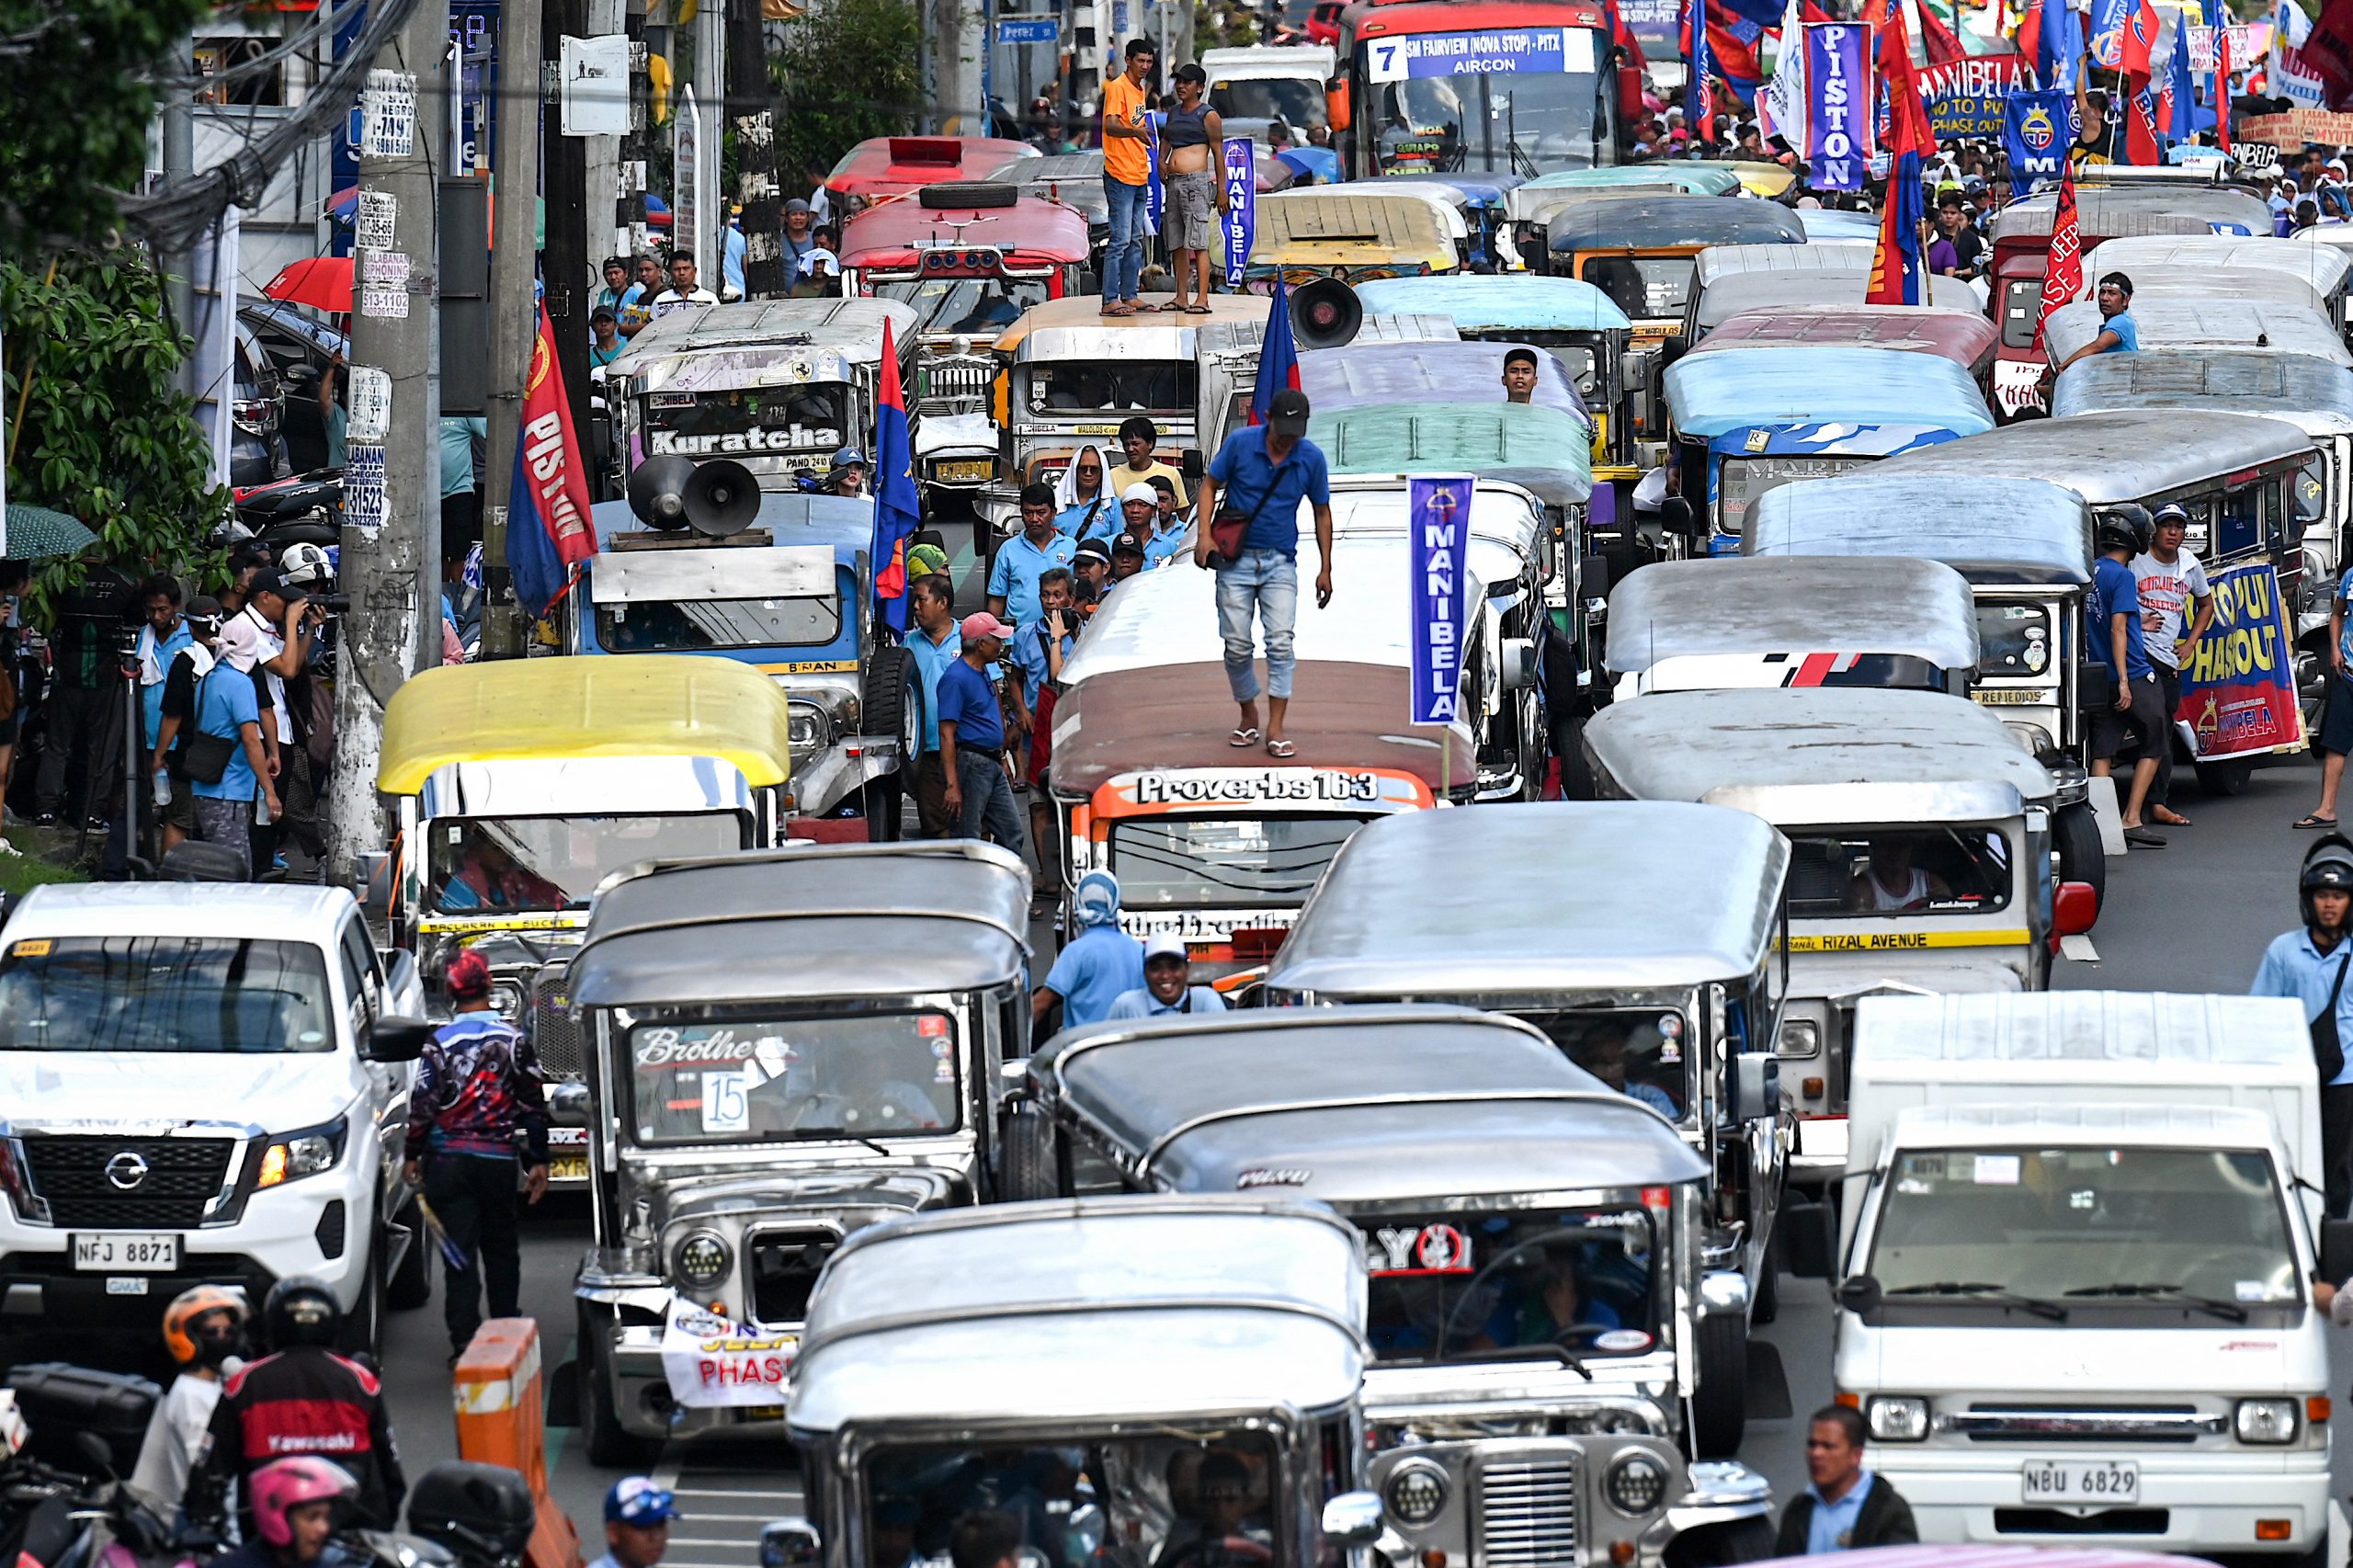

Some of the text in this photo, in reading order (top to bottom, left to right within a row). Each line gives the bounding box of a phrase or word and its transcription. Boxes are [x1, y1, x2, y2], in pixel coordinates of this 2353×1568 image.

[1377, 46, 1396, 71] 7
[1406, 41, 1422, 58] SM
[1423, 38, 1468, 56] FAIRVIEW
[1471, 35, 1501, 58] (NOVA
[1502, 34, 1530, 55] STOP)
[1537, 34, 1561, 51] PITX
[1453, 58, 1516, 74] AIRCON
[1917, 60, 2025, 105] MANIBELA
[1824, 26, 1850, 185] PISTON
[1951, 98, 1975, 114] TO
[1932, 119, 1974, 134] PHASE
[1227, 166, 1245, 282] MANIBELA
[363, 264, 409, 276] SIPHONING
[363, 293, 408, 307] 513-1102
[651, 423, 840, 456] Kuratcha
[2234, 573, 2270, 619] PUV
[1425, 524, 1455, 719] MANIBELA
[2234, 625, 2277, 676] OUT
[1137, 772, 1378, 804] Proverbs 16:3
[1823, 934, 1866, 949] RIZAL
[1870, 932, 1927, 949] AVENUE
[709, 1077, 745, 1122] 15
[78, 1243, 174, 1262] NFJ 8871
[699, 1357, 793, 1385] PHAS
[268, 1433, 356, 1452] Kawasaki
[2027, 1471, 2135, 1494] NBU 6829
